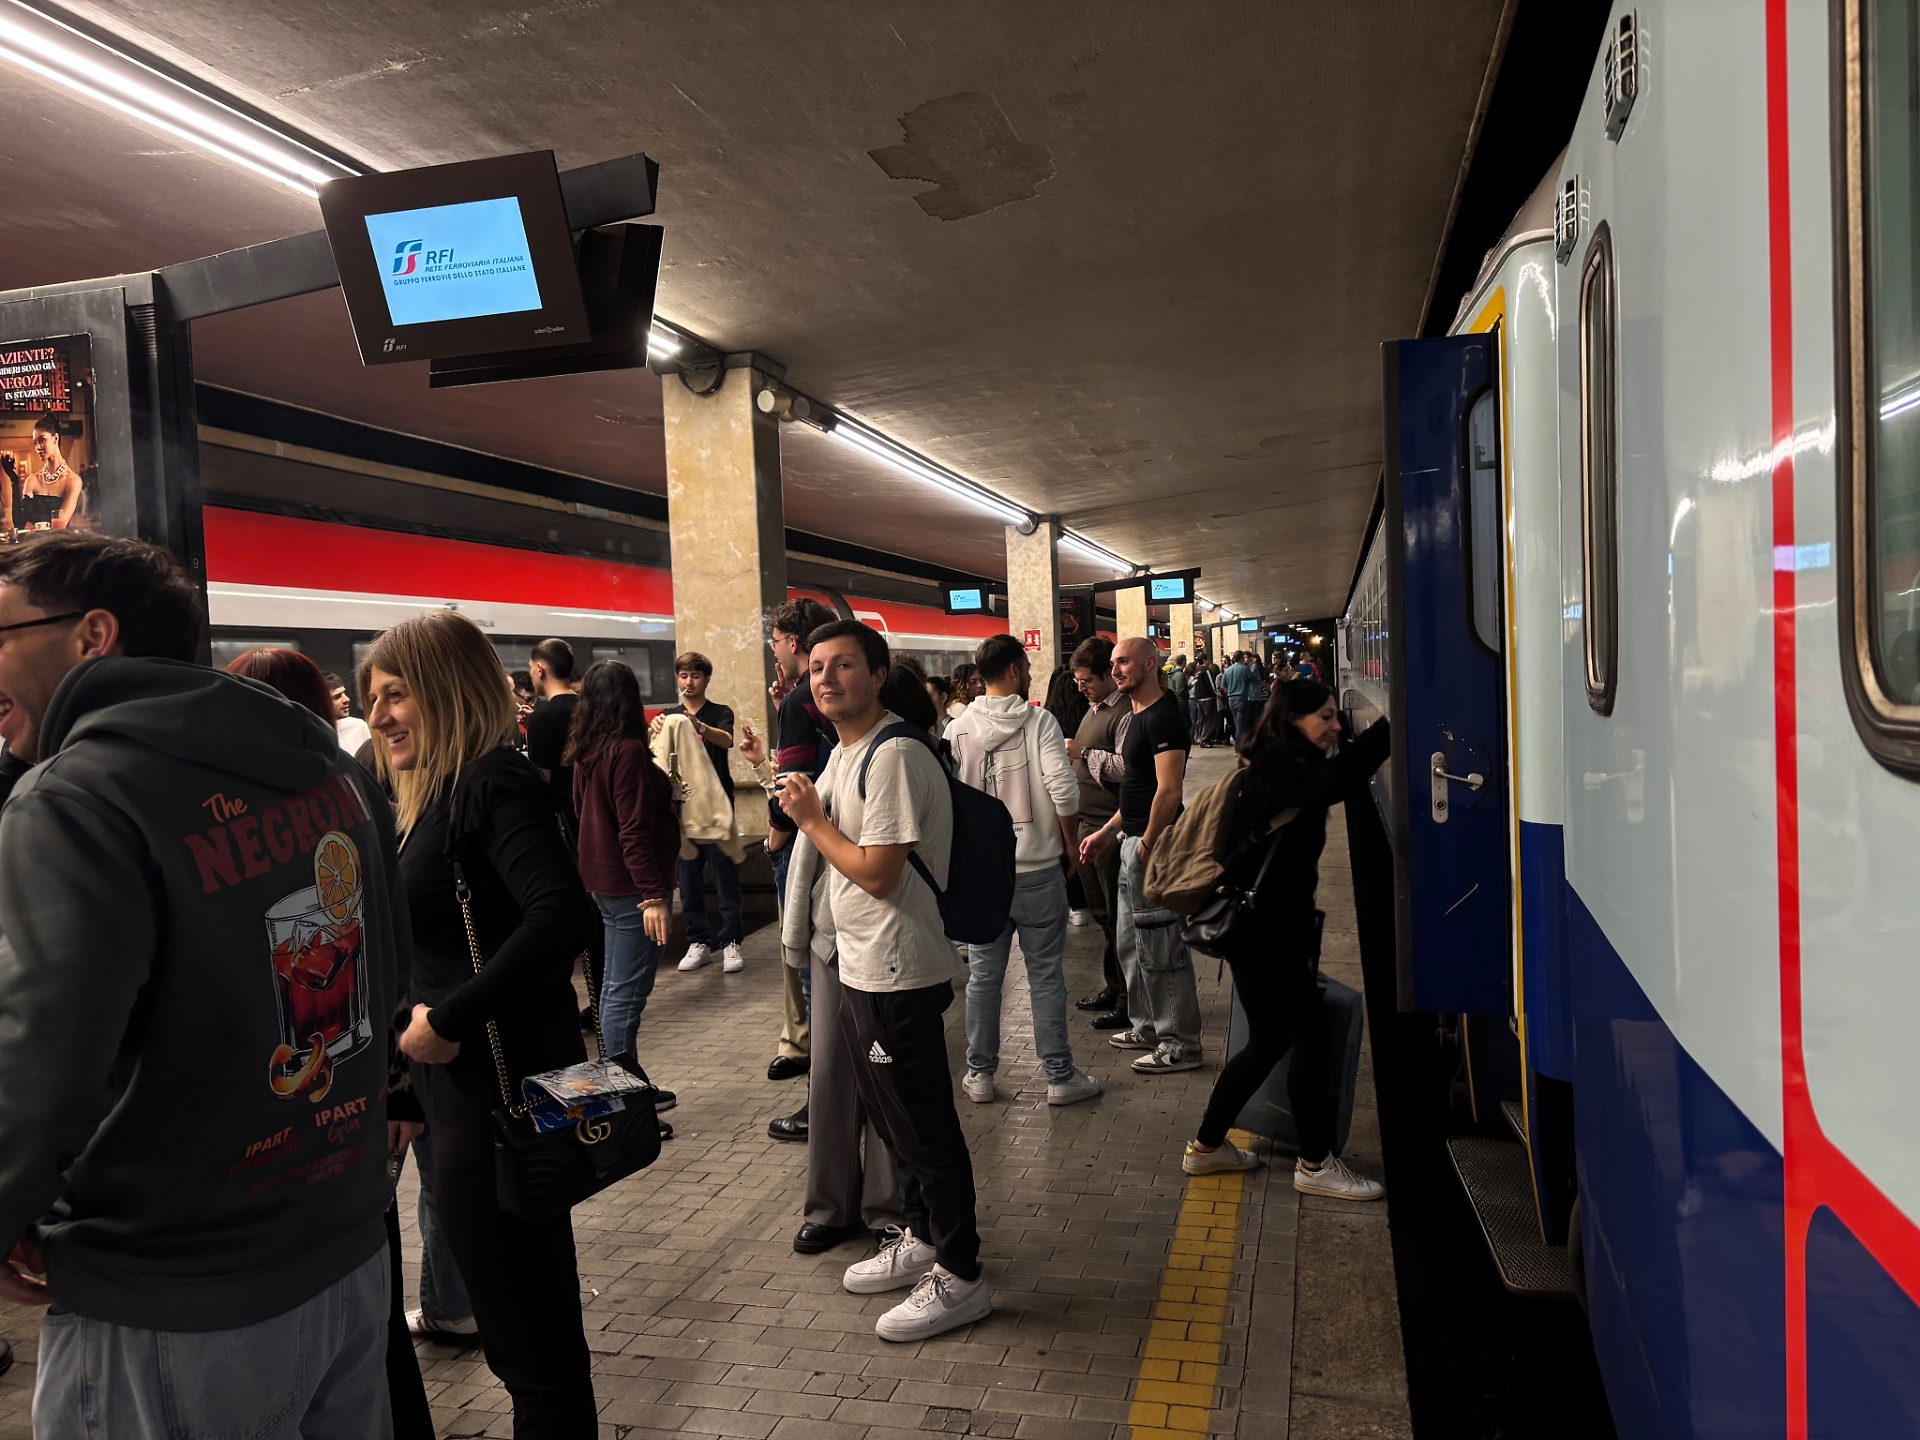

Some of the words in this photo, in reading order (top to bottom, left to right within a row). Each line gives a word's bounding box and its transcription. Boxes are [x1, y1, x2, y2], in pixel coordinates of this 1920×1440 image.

[426, 248, 454, 265] RFI
[444, 260, 491, 271] FERROVIARIA
[492, 255, 524, 265] ITALIANA
[394, 277, 420, 286] GRUPPO
[421, 273, 452, 283] FERROVIE
[453, 270, 474, 279] DELLO
[474, 268, 495, 277] STATO
[496, 264, 527, 274] ITALIANE
[21, 363, 42, 373] SONO
[193, 558, 199, 568] 9
[202, 793, 248, 822] The
[315, 1097, 367, 1128] IPART
[245, 1126, 293, 1159] IPART
